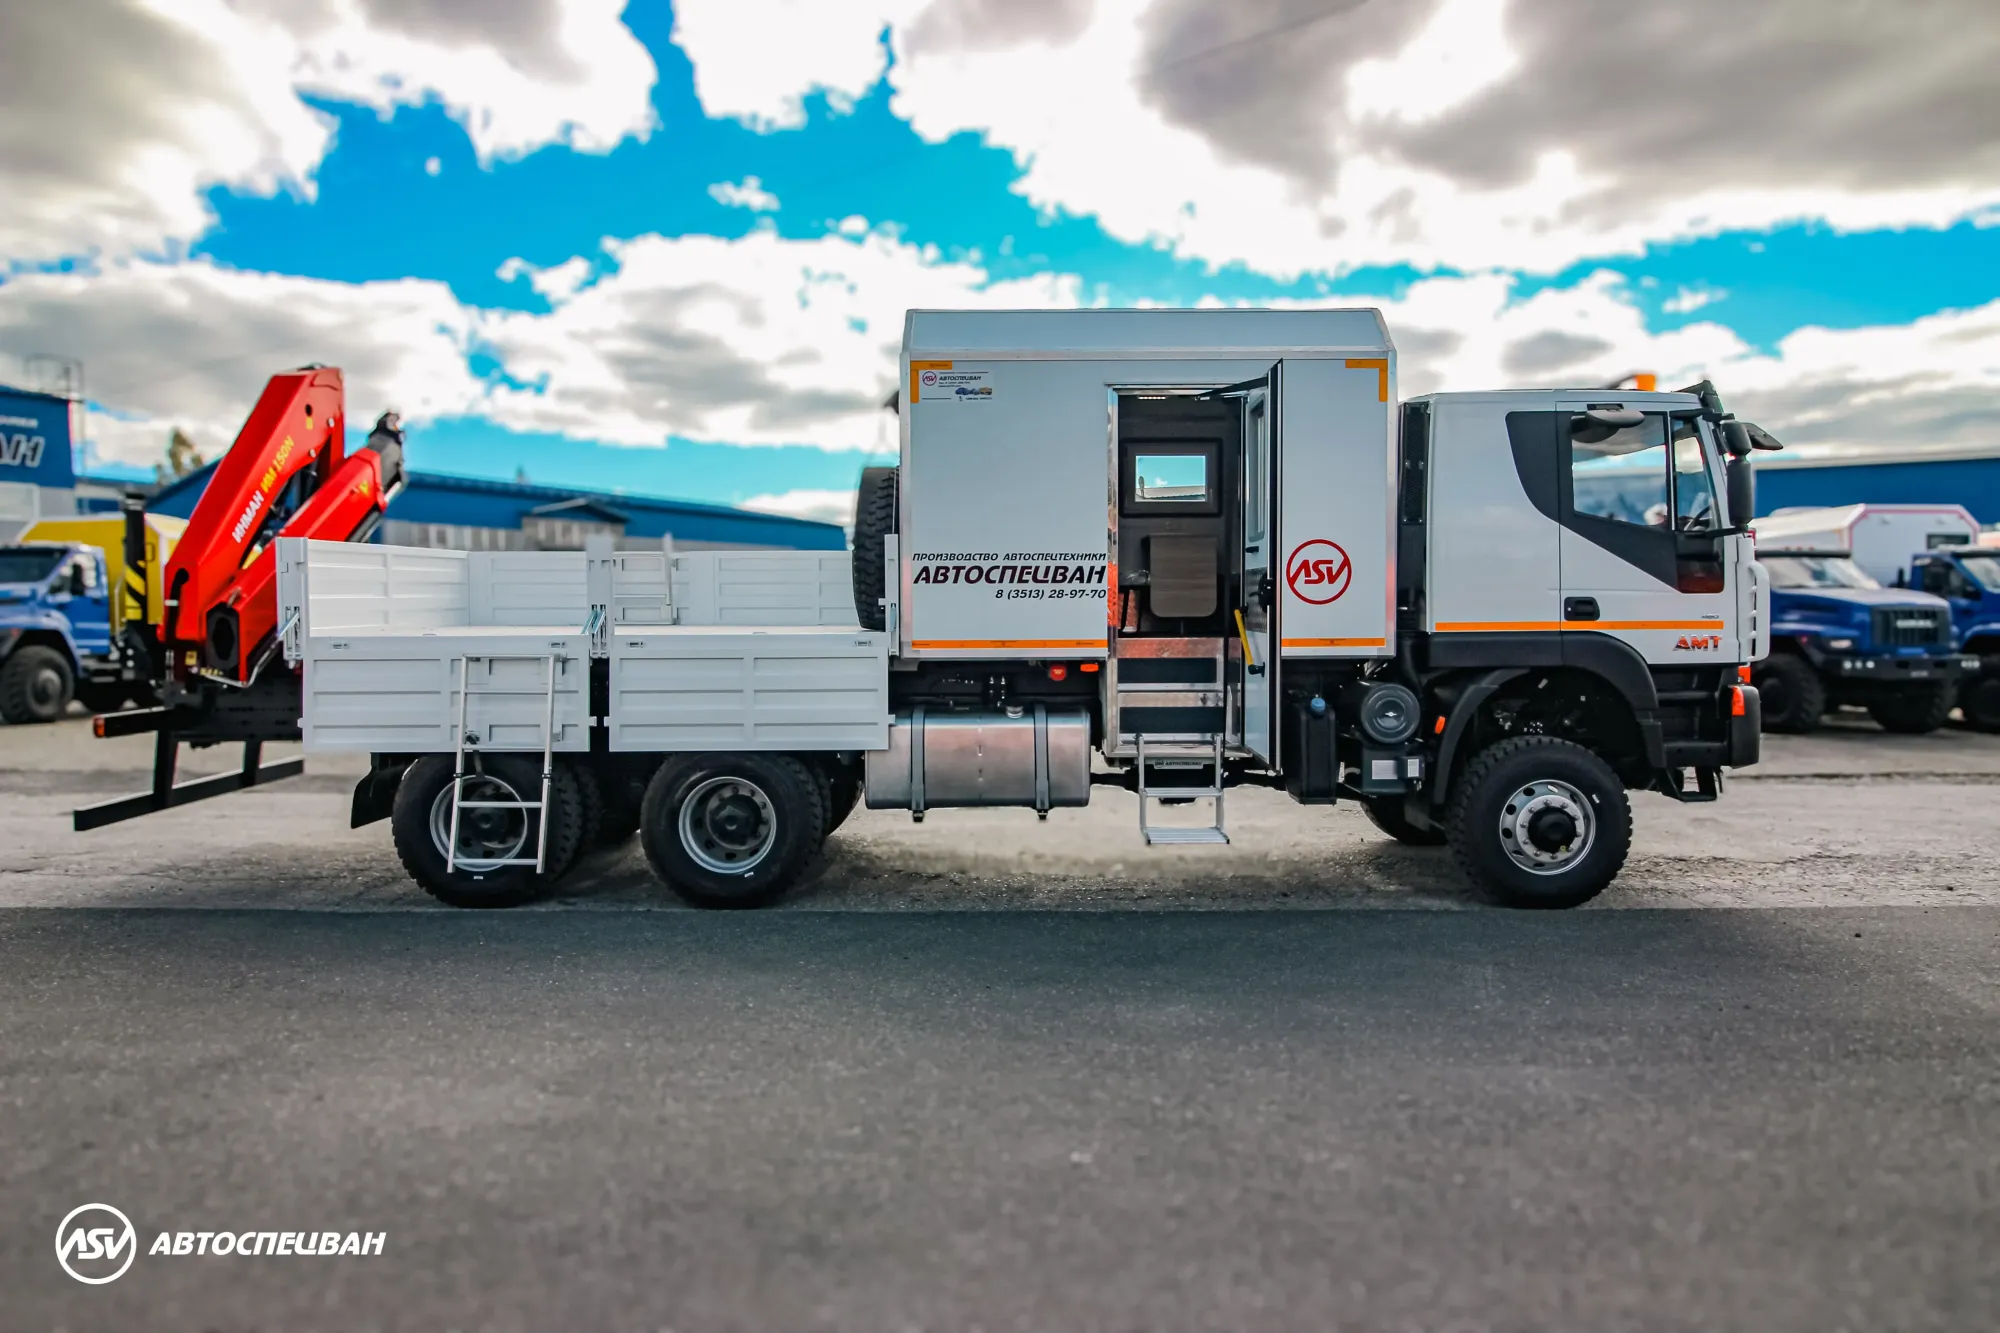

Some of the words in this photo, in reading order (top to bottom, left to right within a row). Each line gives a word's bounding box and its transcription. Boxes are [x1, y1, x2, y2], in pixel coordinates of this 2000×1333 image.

[232, 490, 264, 543] ИНМАН
[912, 553, 998, 562] ПРОИЗВОДСТВО
[1003, 553, 1106, 562] АВТОСПЕЦТЕХНИКИ
[913, 565, 1106, 584] АВТОСПЕЦВАН
[995, 589, 1003, 599] 8
[1007, 589, 1045, 600] (3513)
[1048, 589, 1106, 599] 28-97-70
[1673, 635, 1722, 651] AMT
